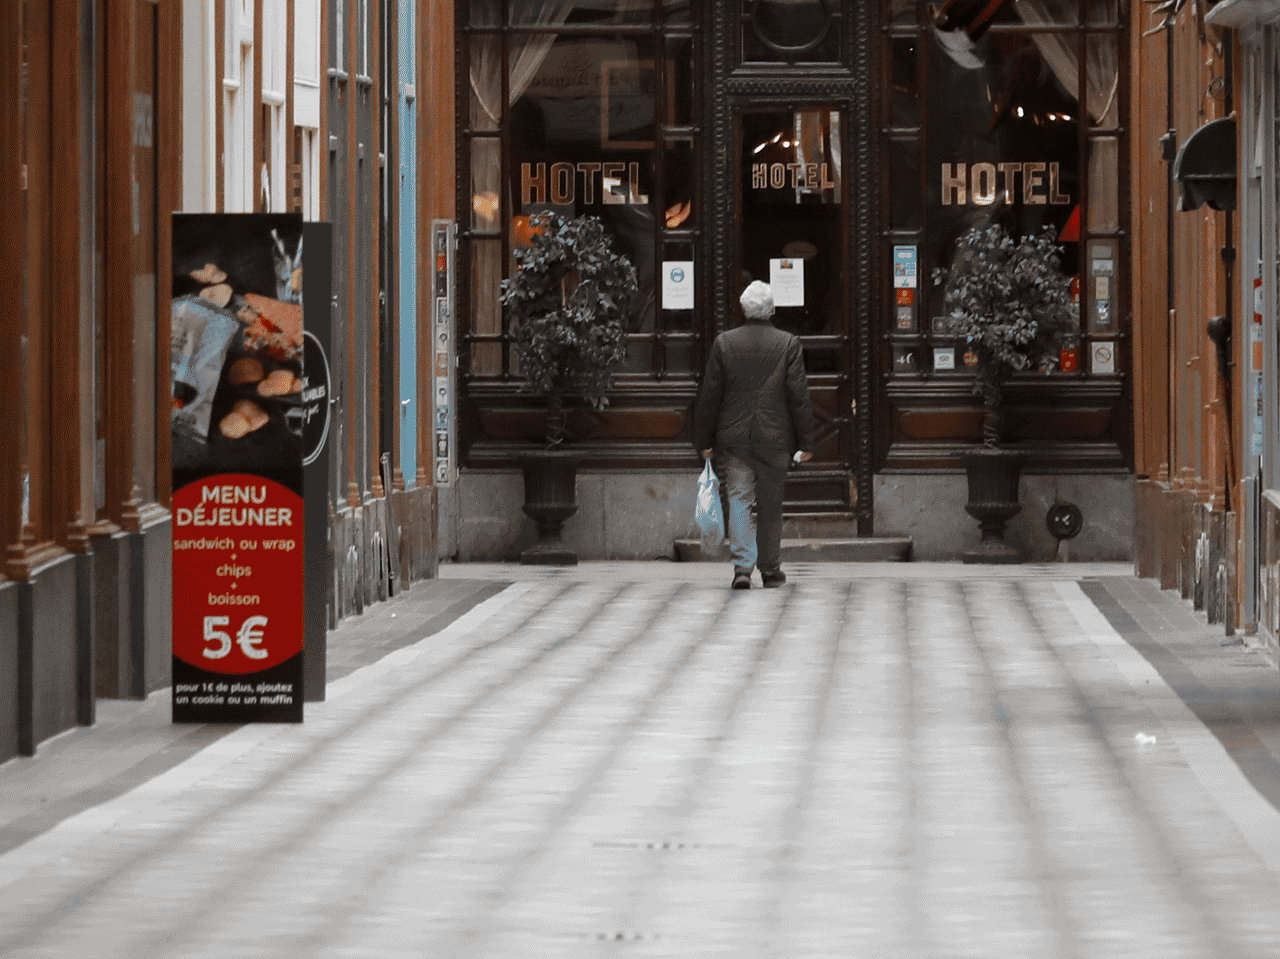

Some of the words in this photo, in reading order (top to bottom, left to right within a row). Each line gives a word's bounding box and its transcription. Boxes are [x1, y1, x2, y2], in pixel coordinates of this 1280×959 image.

[521, 162, 650, 205] HOTEL
[752, 162, 835, 190] HOTEL
[941, 161, 1071, 205] HOTEL
[201, 485, 267, 504] MENU
[176, 501, 293, 527] DÉJEUNER
[174, 537, 235, 550] sandwich
[240, 540, 258, 550] ou
[262, 540, 296, 553] wrap
[216, 563, 252, 579] chips
[207, 592, 261, 605] boisson
[202, 615, 269, 660] 5€
[176, 684, 199, 694] pour
[202, 682, 214, 692] 1€
[216, 682, 228, 692] de
[231, 682, 255, 694] plus,
[257, 682, 293, 694] ajoutez
[176, 696, 189, 704] un
[192, 694, 225, 704] cookie
[228, 696, 241, 704] ou
[244, 696, 257, 704] un
[260, 694, 293, 705] muffin
